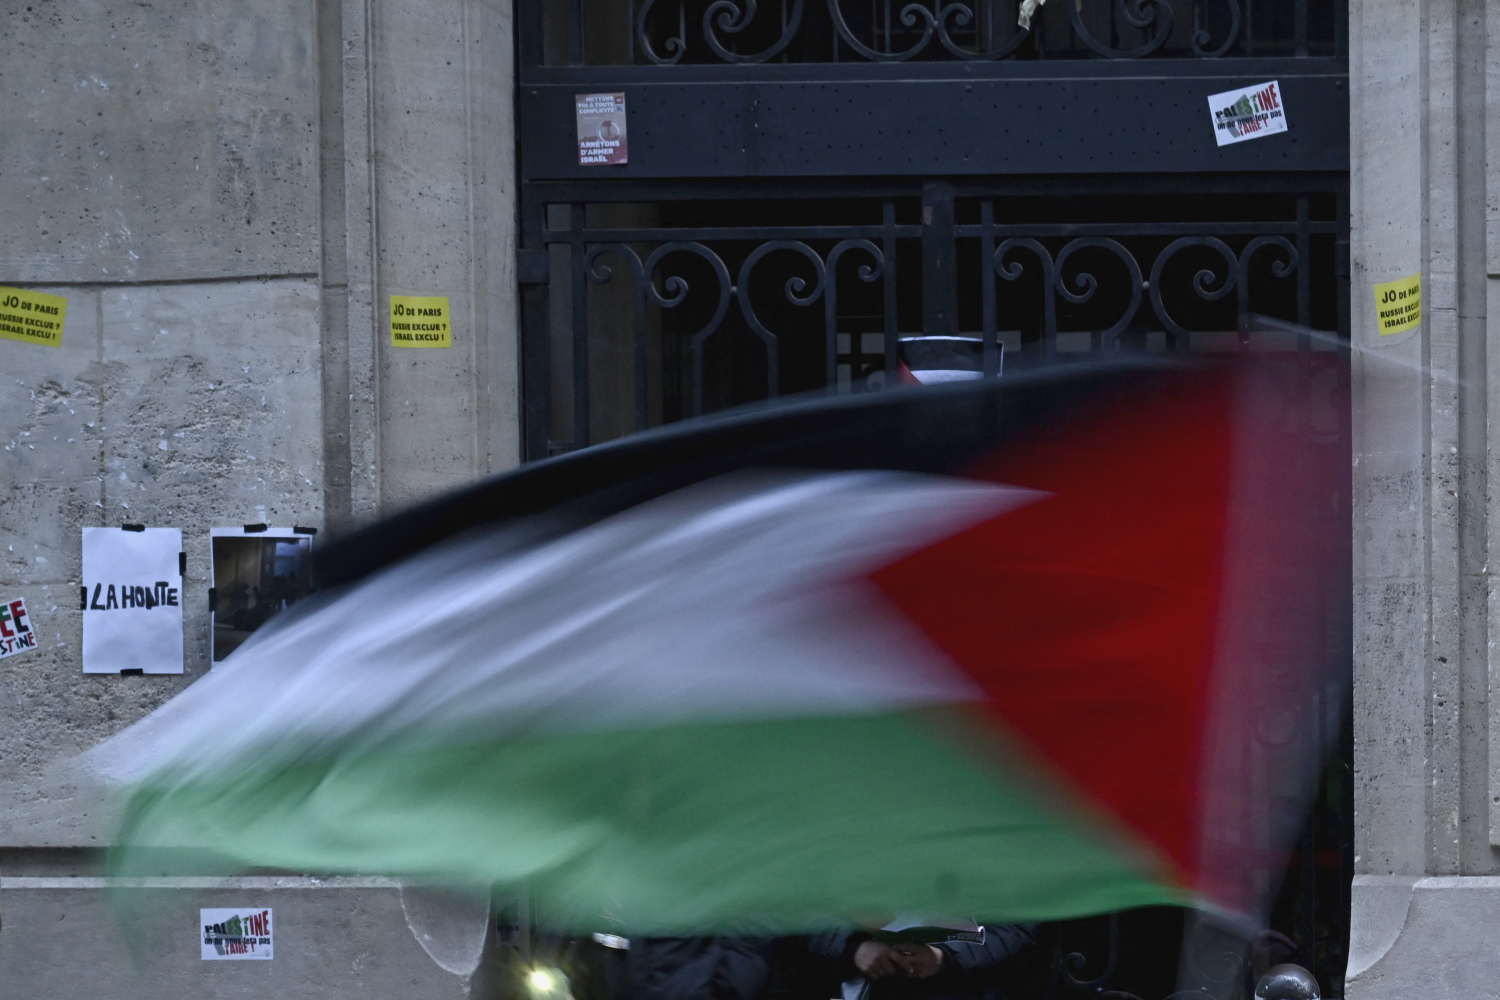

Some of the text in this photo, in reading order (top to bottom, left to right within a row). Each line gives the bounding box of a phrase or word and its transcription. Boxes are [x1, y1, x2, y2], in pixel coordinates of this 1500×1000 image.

[1215, 84, 1280, 118] PALESTINE
[1270, 110, 1282, 119] pas
[1382, 290, 1396, 304] JO
[1399, 290, 1407, 300] DE
[3, 295, 58, 315] JO DE PARIS
[394, 304, 442, 316] JO DE PARIS
[1380, 307, 1403, 318] RUSSIE
[25, 318, 54, 329] EXCLUE
[392, 322, 410, 330] RUSSIE
[1385, 317, 1406, 328] ISRAEL
[26, 328, 50, 339] EXCLU
[394, 333, 414, 341] ISRAEL
[90, 581, 178, 611] LA HONTE
[205, 910, 270, 936] PALESTINE
